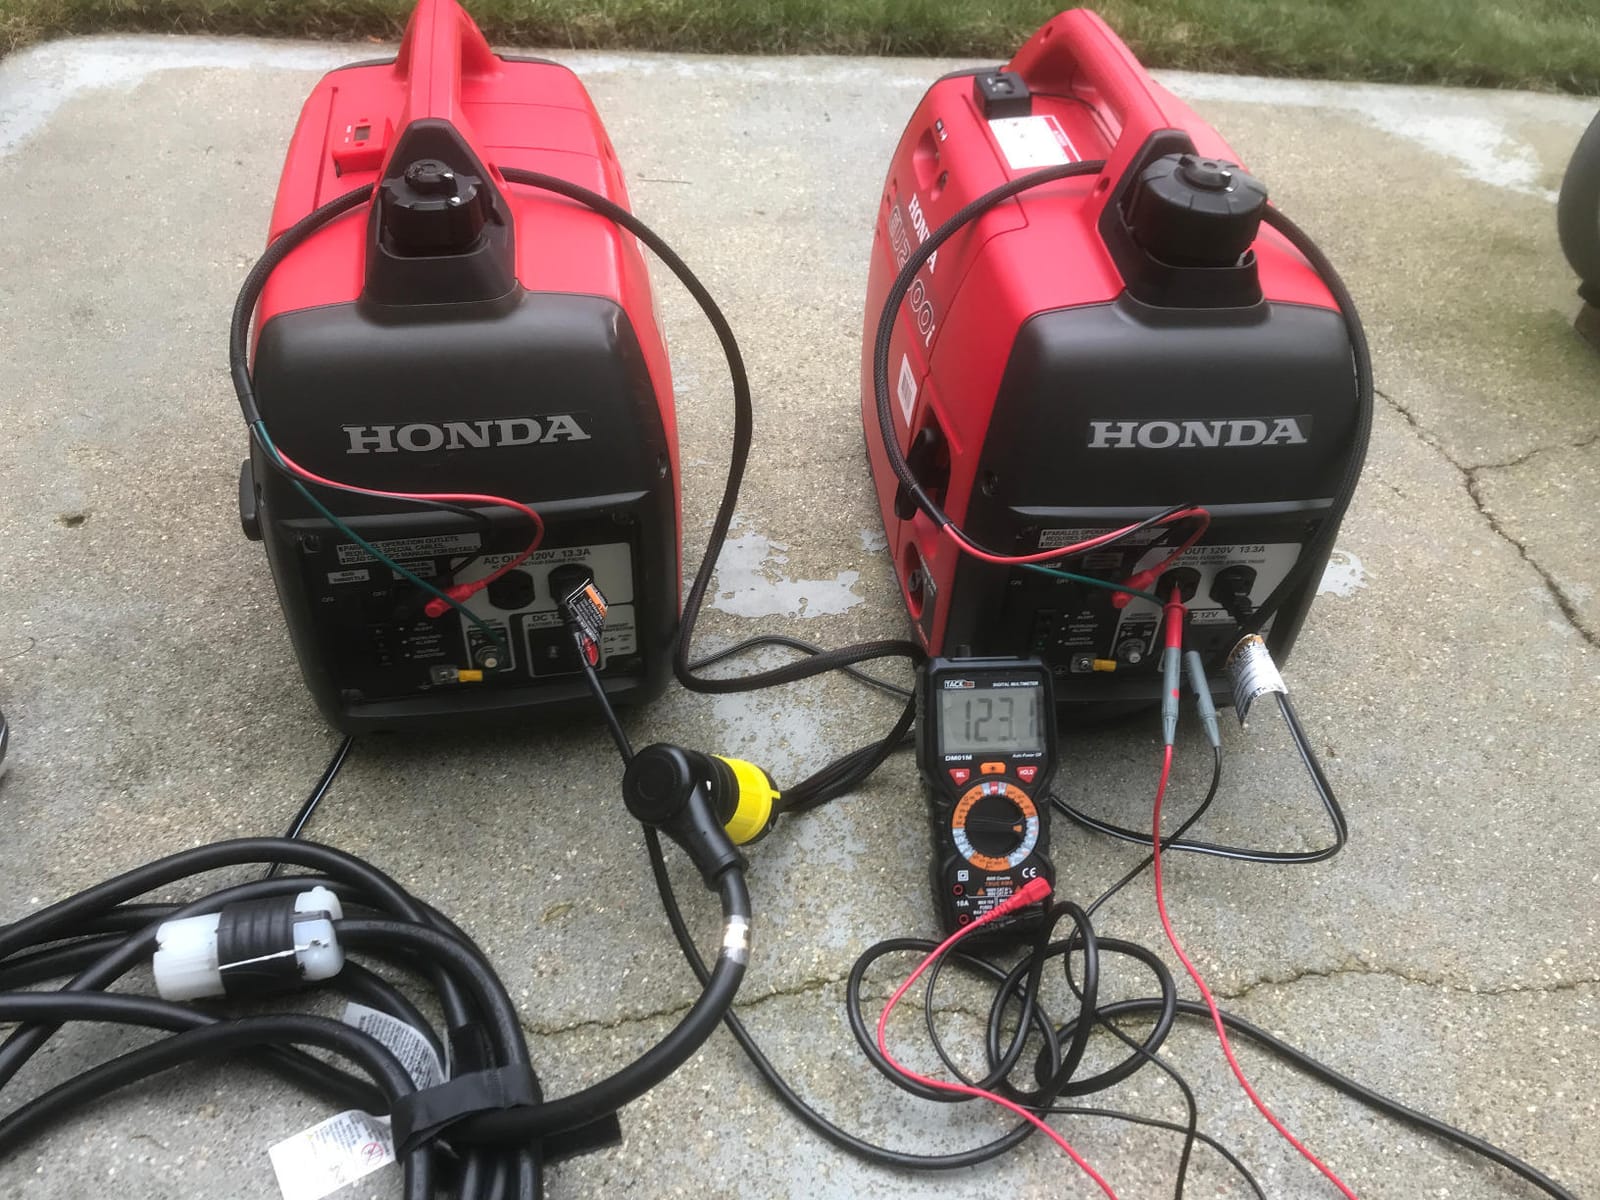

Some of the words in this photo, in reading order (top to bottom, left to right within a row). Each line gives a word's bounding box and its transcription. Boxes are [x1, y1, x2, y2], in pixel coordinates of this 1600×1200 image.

[908, 192, 937, 275] HONA
[889, 204, 936, 348] EU200i
[344, 415, 591, 454] HONDA
[1087, 418, 1308, 449] HONDA
[382, 538, 424, 546] OPERATION
[425, 535, 459, 543] OUTLETS
[1184, 547, 1206, 555] OUT
[1209, 546, 1234, 554] 120V
[1239, 545, 1265, 553] 13.3A
[483, 556, 500, 565] AC
[530, 551, 556, 561] 120V
[561, 548, 591, 558] 13.3A
[532, 613, 548, 622] DC
